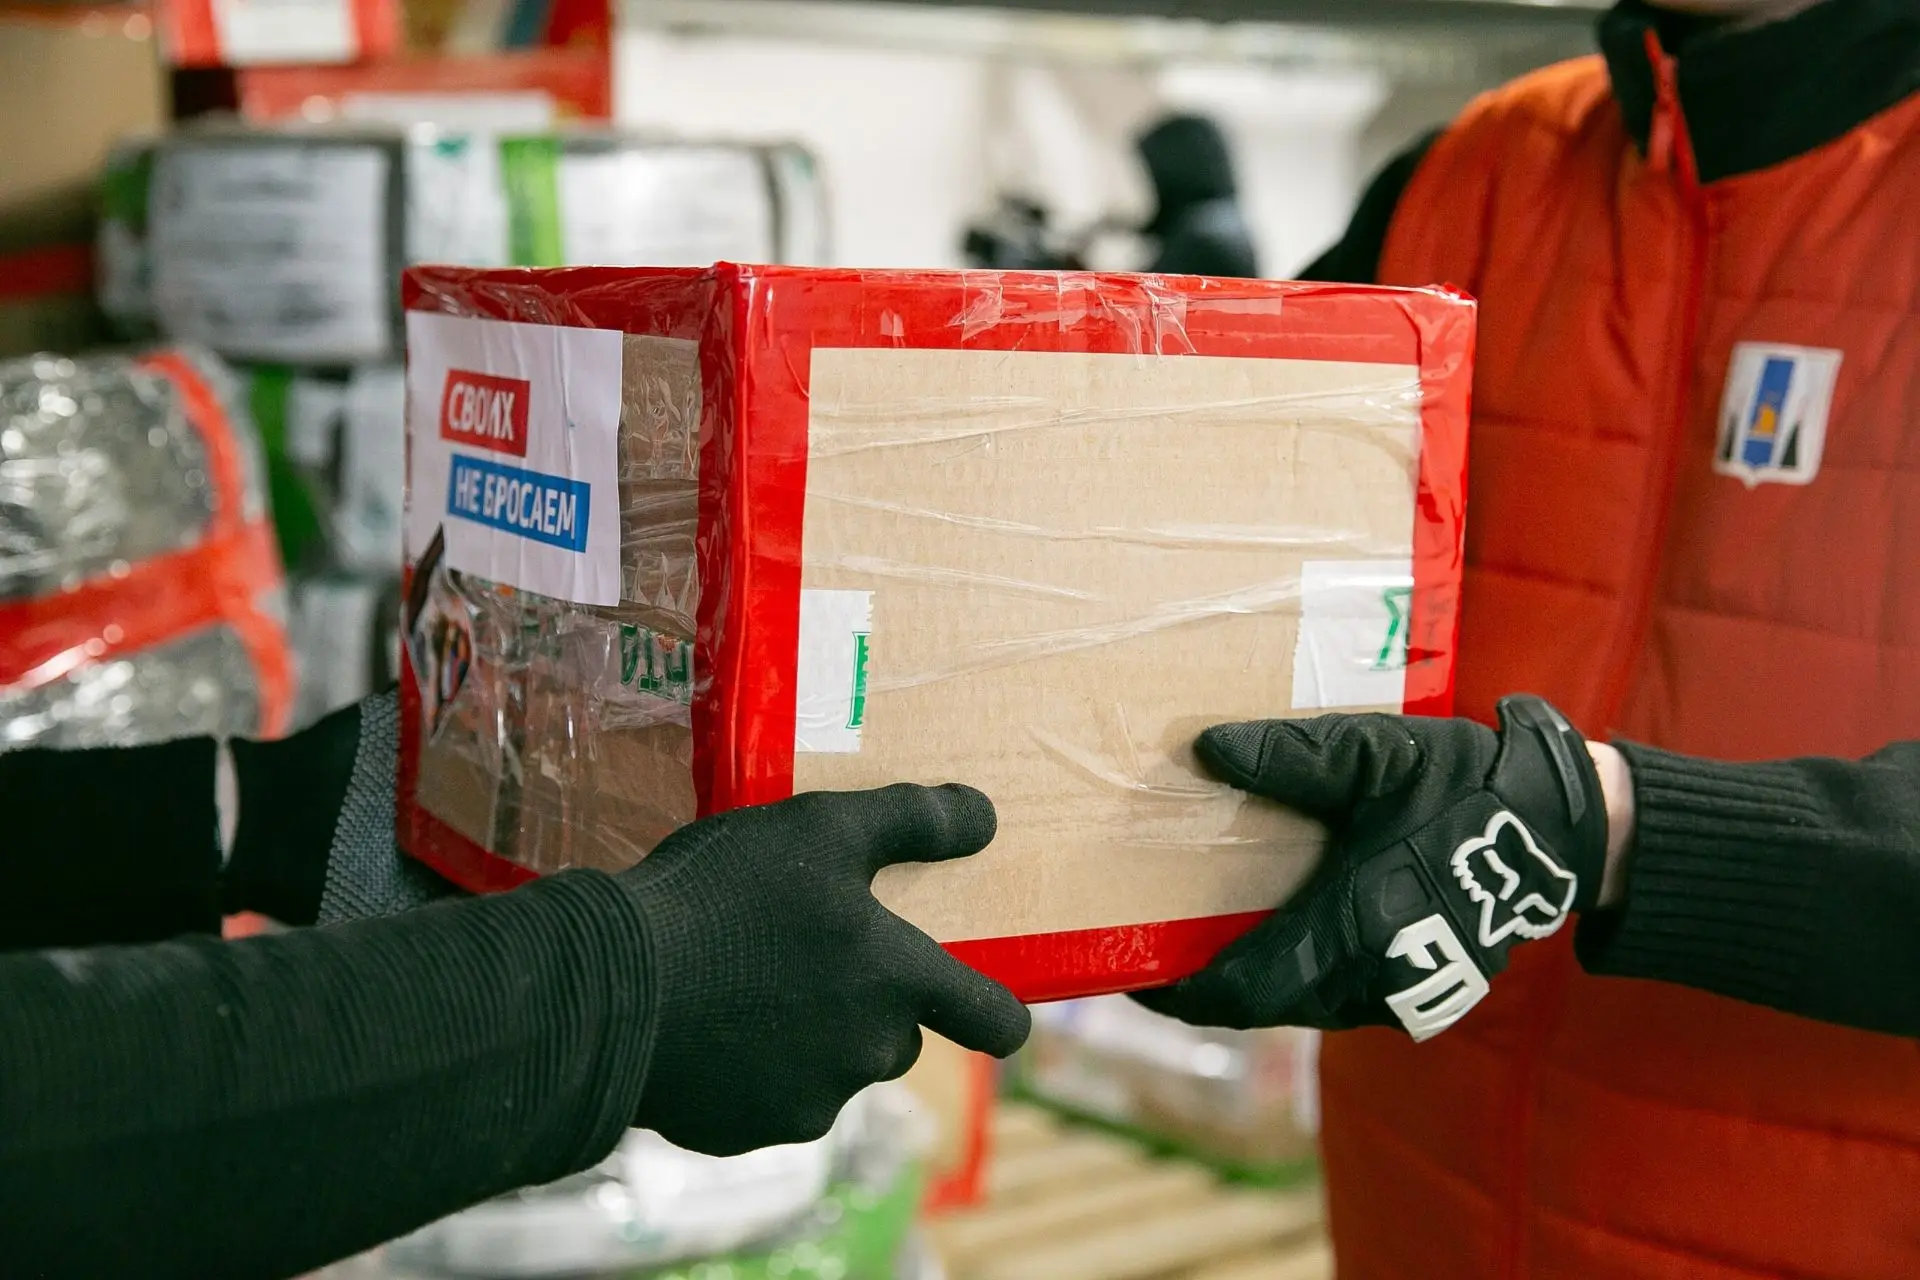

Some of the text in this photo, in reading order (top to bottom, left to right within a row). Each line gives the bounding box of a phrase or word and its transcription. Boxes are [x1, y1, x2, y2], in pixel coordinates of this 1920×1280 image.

[448, 382, 516, 442] СВОИХ
[455, 466, 577, 540] НЕ БРОСАЕМ
